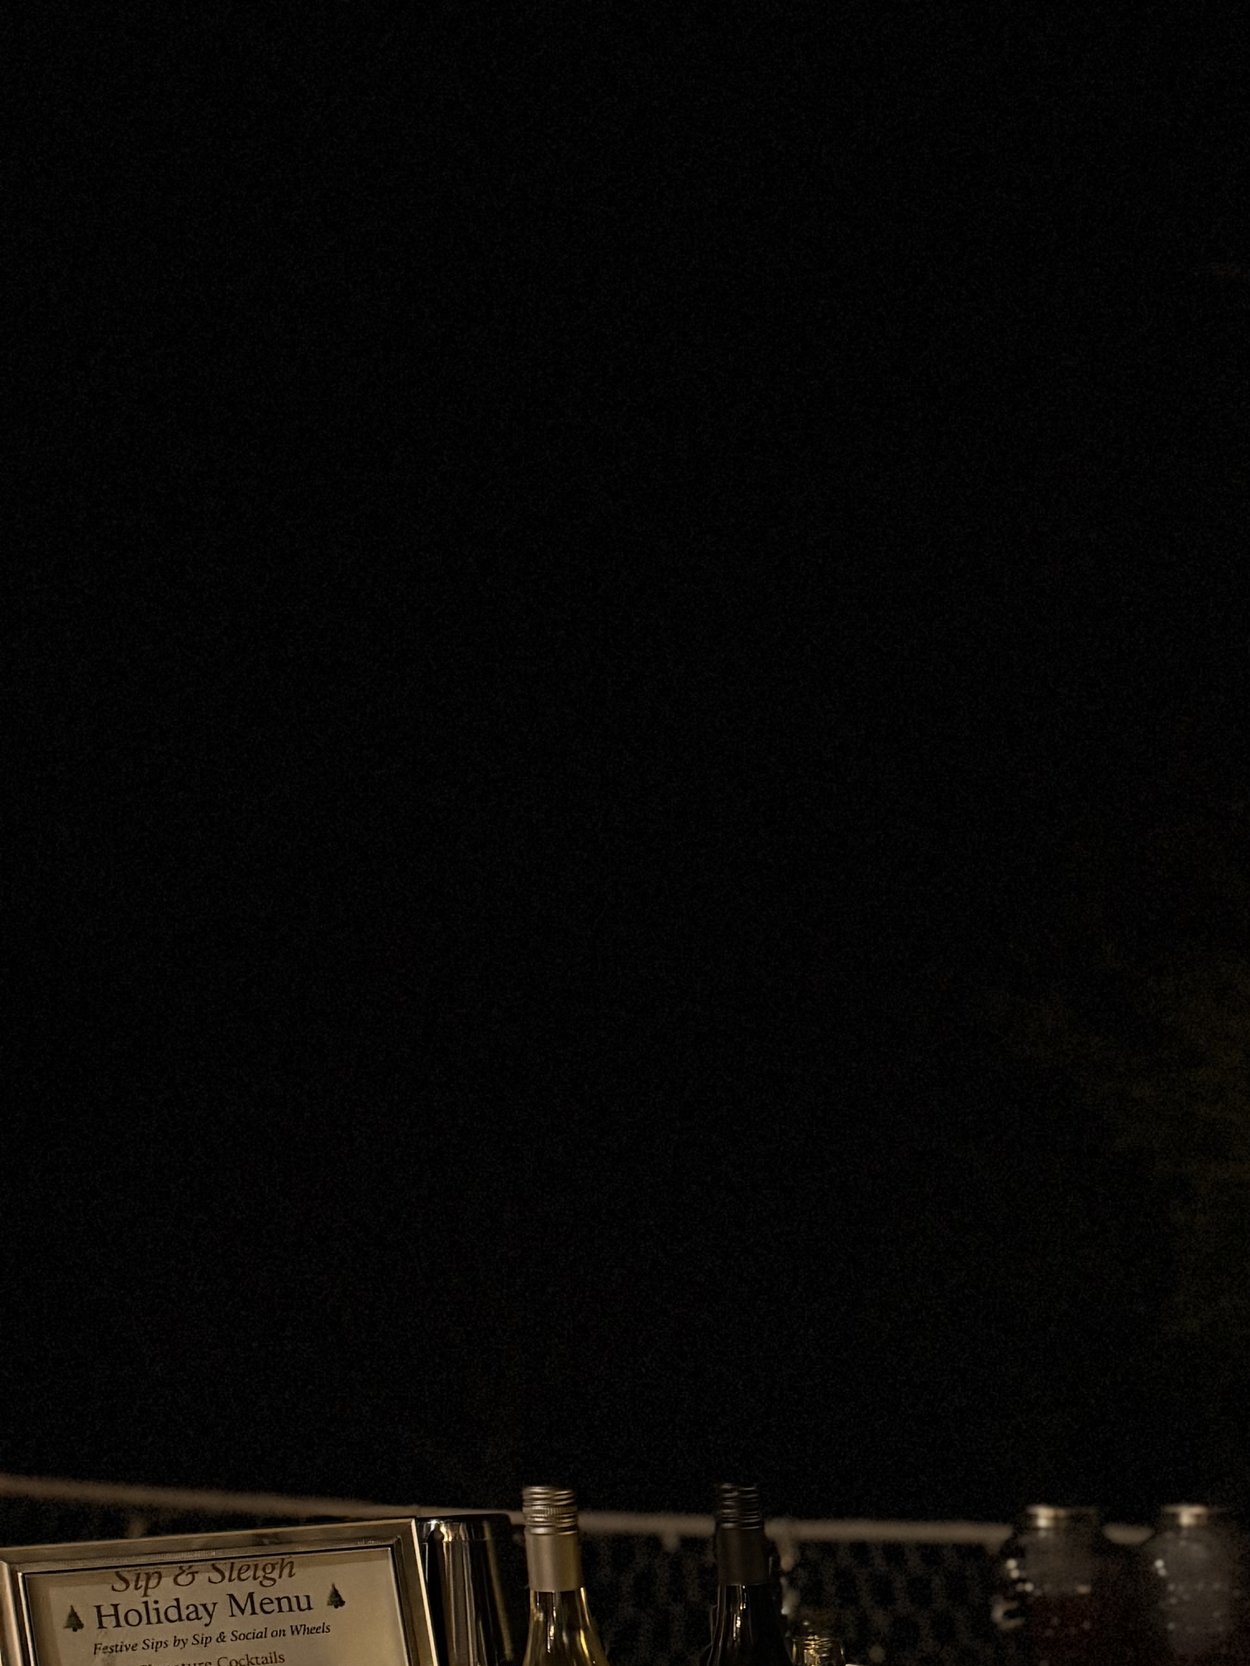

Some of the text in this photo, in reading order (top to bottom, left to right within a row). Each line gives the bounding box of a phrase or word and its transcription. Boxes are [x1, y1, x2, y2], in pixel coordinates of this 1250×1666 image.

[112, 1557, 296, 1597] Sip & Sleigh
[93, 1591, 314, 1630] Holiday Menu
[93, 1622, 331, 1655] Festive Sips by Sip & Social on Wheels
